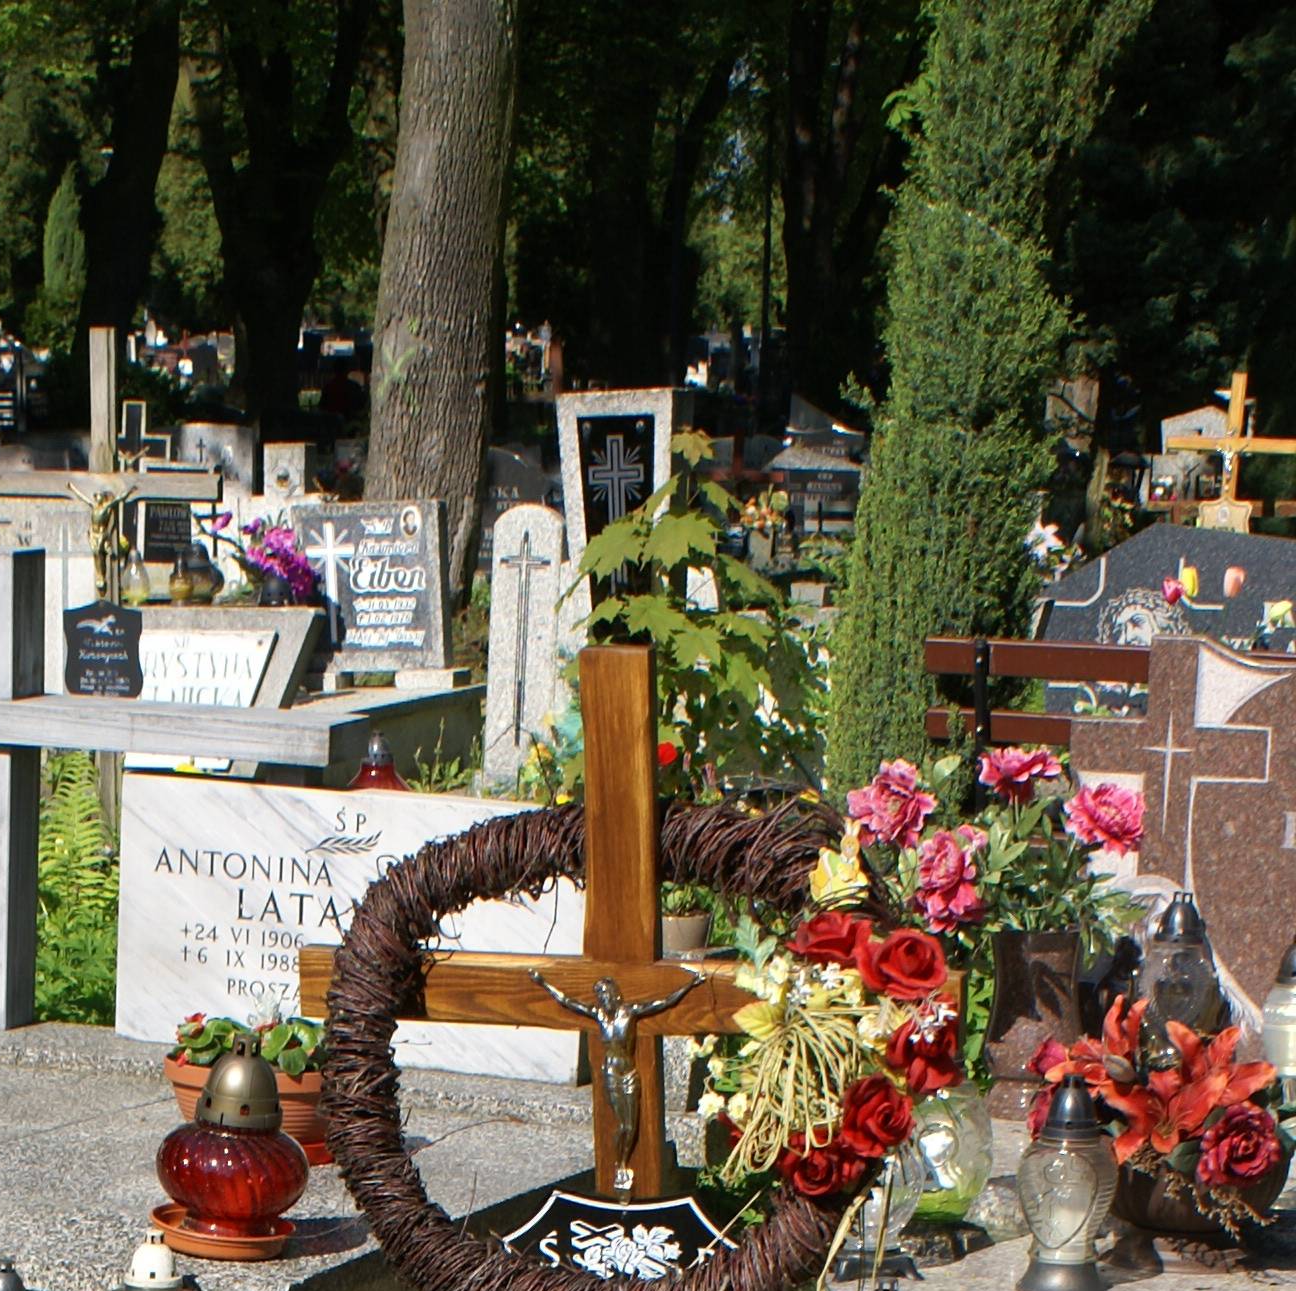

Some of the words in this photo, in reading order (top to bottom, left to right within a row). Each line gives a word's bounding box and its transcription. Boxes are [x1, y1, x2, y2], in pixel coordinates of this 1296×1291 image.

[350, 556, 426, 592] Eiben
[144, 651, 253, 679] RYSTYNA
[154, 846, 334, 888] ANTONINA
[236, 887, 342, 928] LATA
[230, 926, 251, 947] VI
[261, 929, 304, 951] 1906
[225, 950, 246, 970] IX
